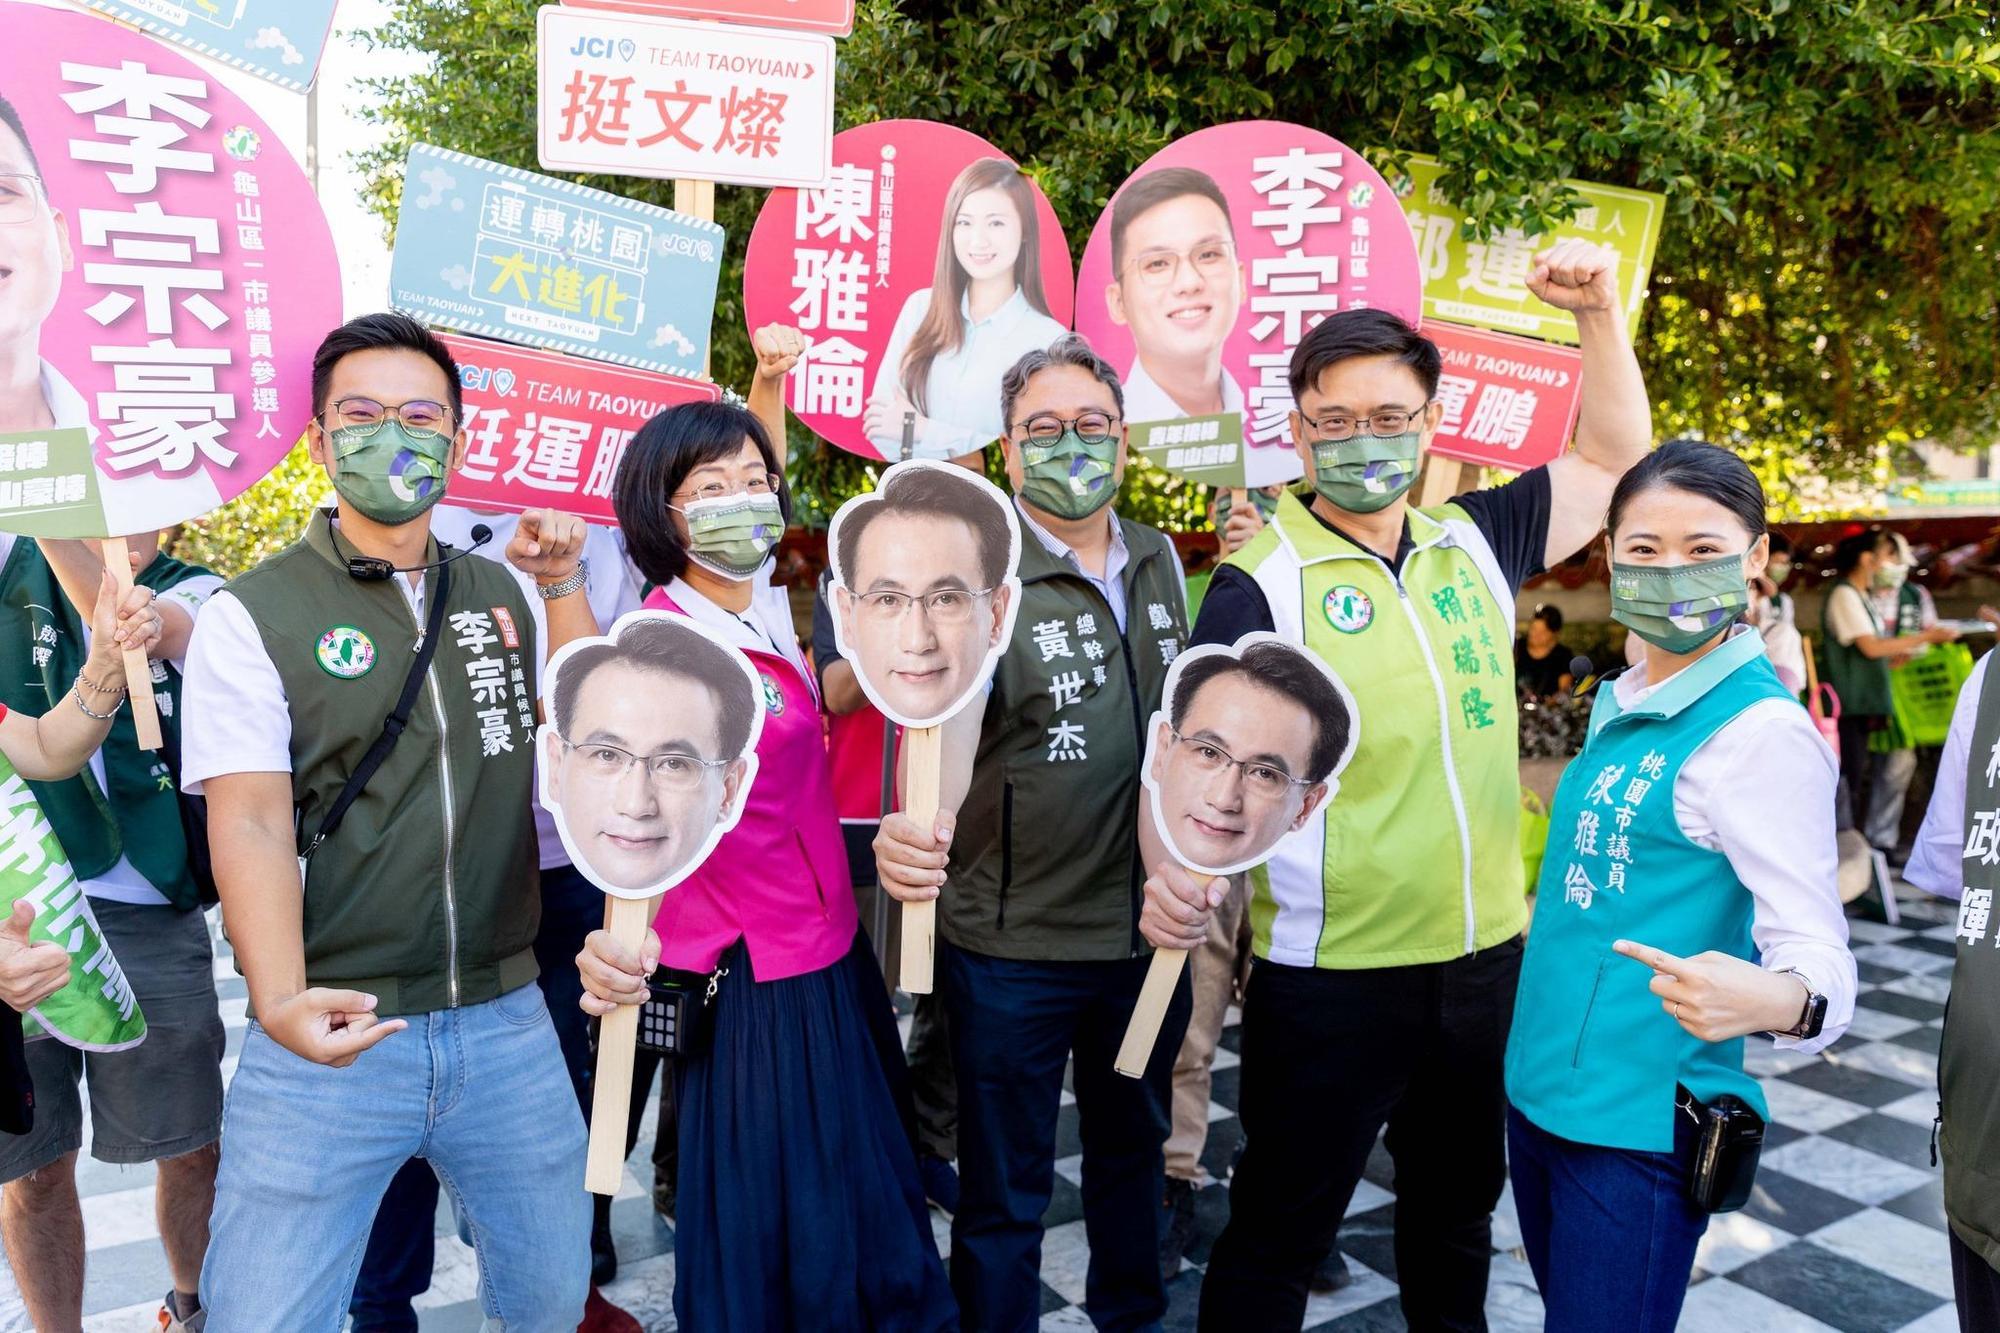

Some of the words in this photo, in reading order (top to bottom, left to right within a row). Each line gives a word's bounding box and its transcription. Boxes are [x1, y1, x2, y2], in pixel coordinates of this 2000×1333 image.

[570, 36, 615, 59] JCI
[648, 47, 701, 68] TEAM
[707, 53, 799, 79] TAOYUAN
[558, 69, 789, 159] 挺文燦
[58, 59, 240, 472] 李宗豪
[488, 194, 645, 264] 運轉桃園
[663, 234, 698, 257] JCI
[397, 289, 425, 304] TEAM
[426, 297, 477, 317] TAOYUAN
[488, 252, 629, 324] 大進化
[788, 163, 875, 418] 陳雅倫
[526, 380, 582, 407] TEAM
[1474, 354, 1558, 385] TAOYUAN
[448, 610, 515, 758] 李宗豪
[1031, 619, 1088, 762] 黃世杰
[1075, 612, 1108, 687] 總幹事
[1431, 586, 1496, 730] 賴瑞隆
[1564, 763, 1627, 910] 陳雅倫
[1603, 749, 1668, 895] 桃園市議員
